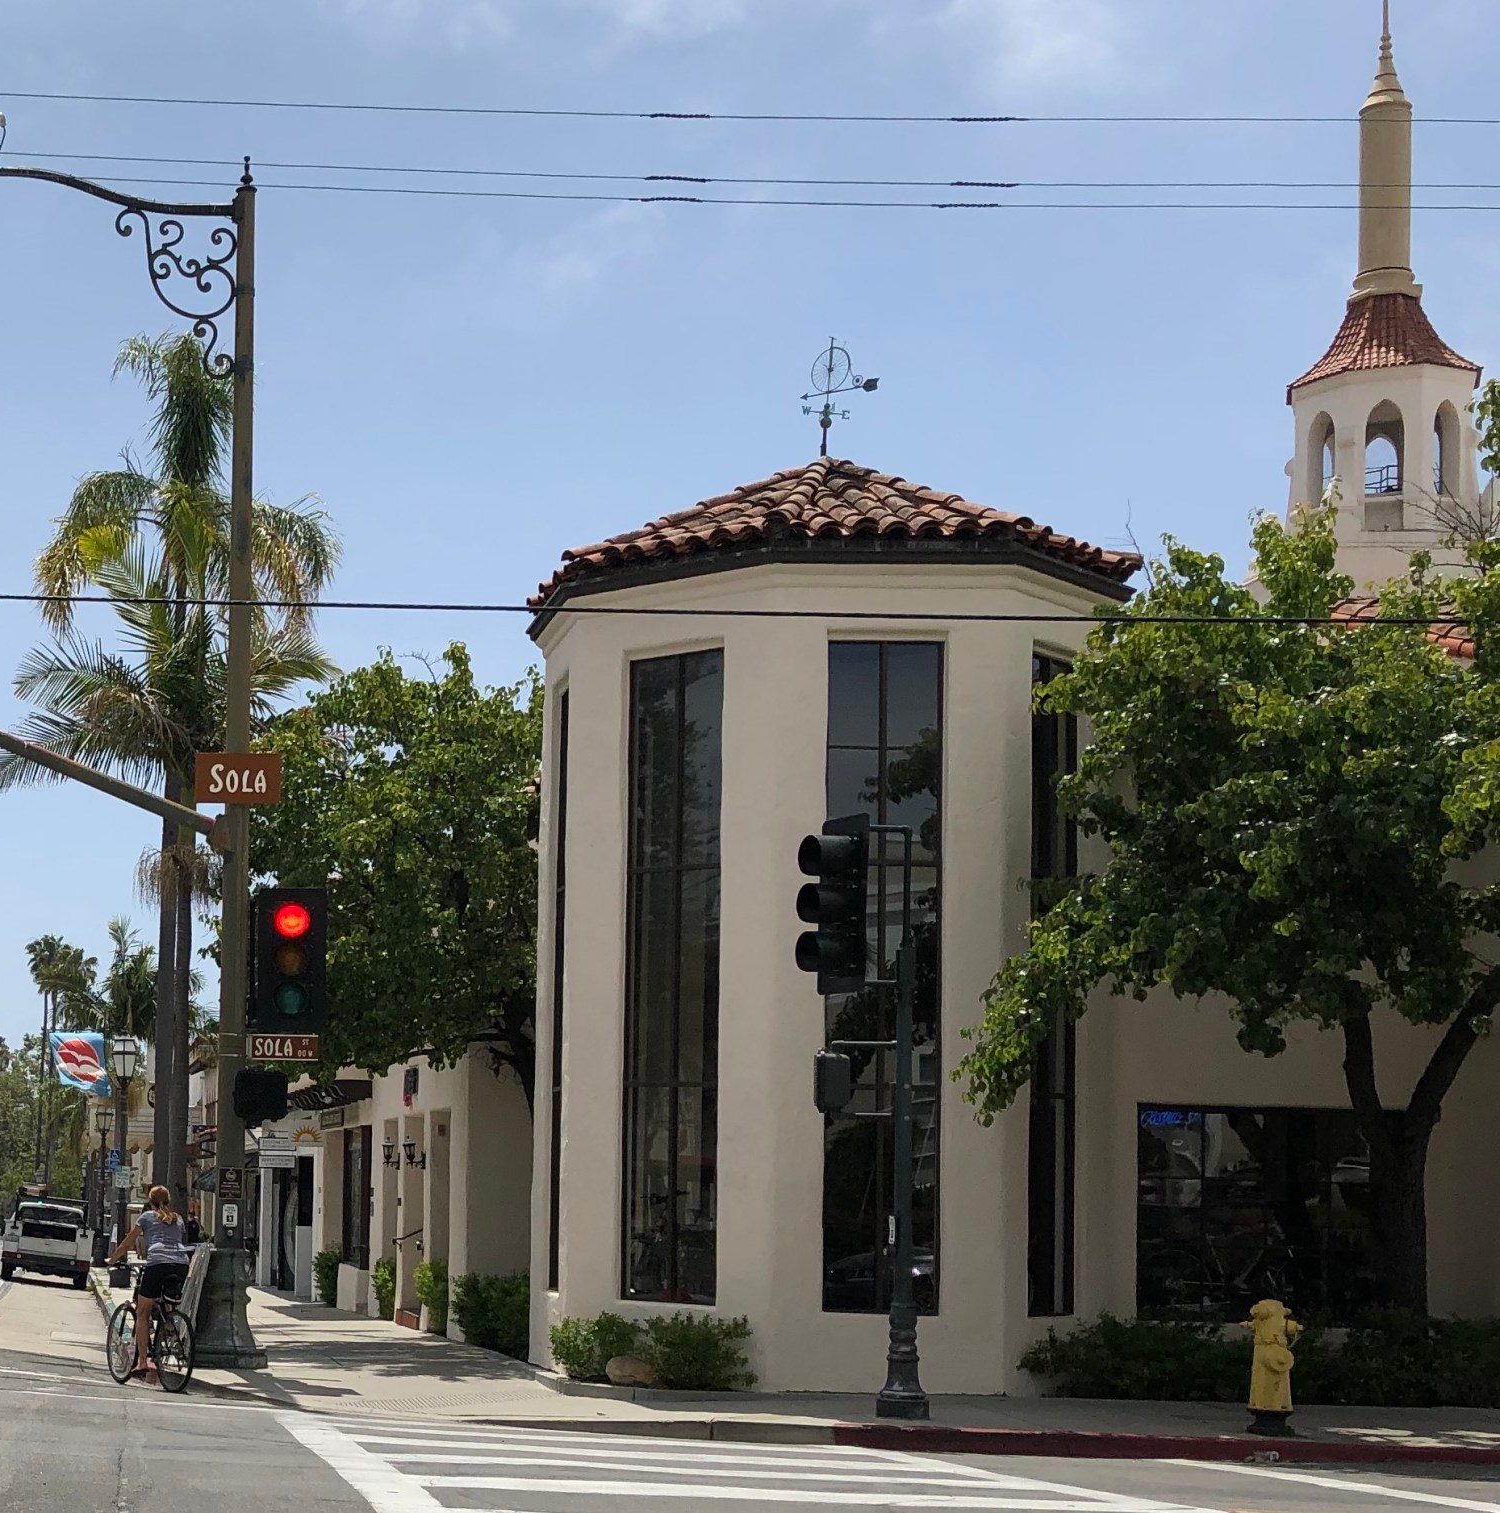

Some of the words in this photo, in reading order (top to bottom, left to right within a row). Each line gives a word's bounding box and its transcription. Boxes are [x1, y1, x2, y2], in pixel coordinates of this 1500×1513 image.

[209, 763, 267, 793] SOLA
[254, 1038, 293, 1056] SOLA
[302, 1038, 310, 1046] ST
